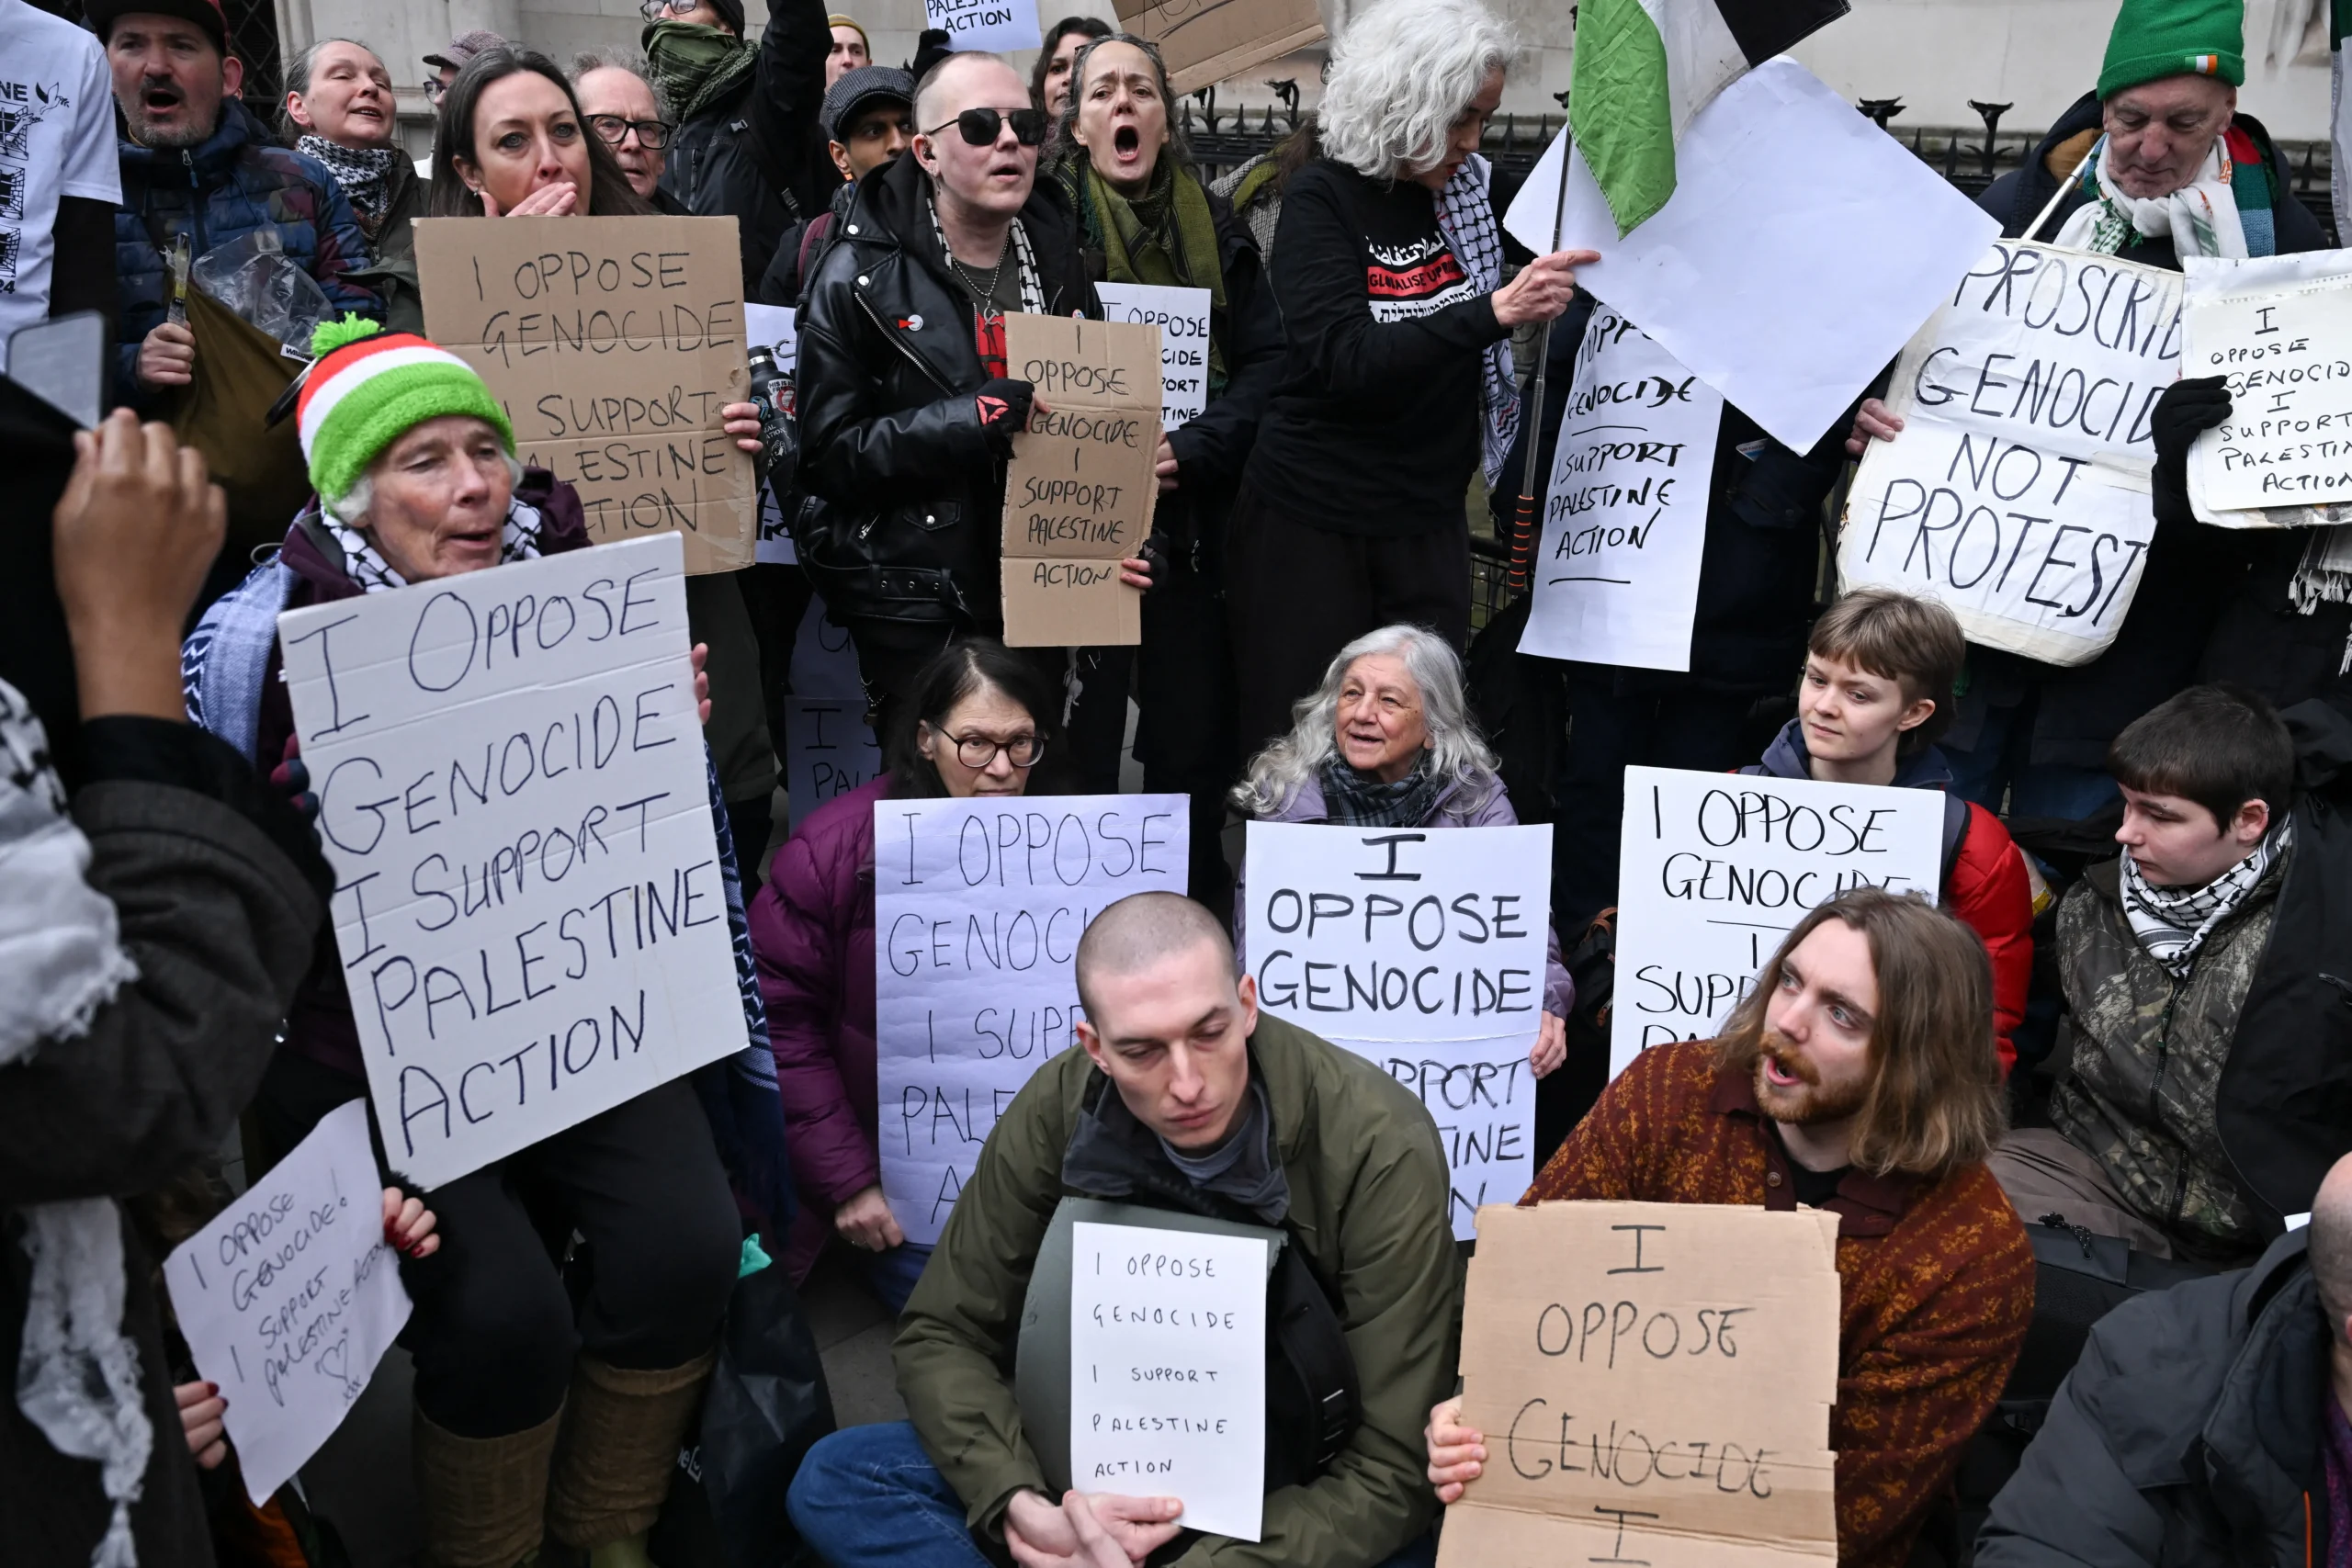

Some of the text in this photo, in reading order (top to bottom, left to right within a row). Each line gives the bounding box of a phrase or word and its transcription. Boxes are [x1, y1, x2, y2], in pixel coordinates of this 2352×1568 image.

[944, 8, 1012, 33] ACTION
[473, 252, 690, 301] I OPPOSE
[1128, 308, 1208, 337] OPPOSE
[1953, 243, 2182, 360] PROSCRI
[2255, 307, 2279, 334] I
[482, 300, 736, 367] GENOCIDE
[1077, 324, 1081, 355] I
[1162, 348, 1202, 366] CIDE
[1588, 315, 1653, 363] OPP
[2211, 338, 2309, 365] OPPOSE
[1024, 359, 1129, 395] OPPOSE
[1567, 376, 1697, 420] GENOCIDE
[1913, 346, 2167, 445] GENOCID
[2225, 361, 2350, 399] GENOCID
[2267, 389, 2296, 413] I
[537, 385, 717, 436] SUPPORT
[1031, 411, 1139, 448] GENOCIDE
[2220, 412, 2352, 442] SUPPORT
[528, 436, 728, 484] LESTINE
[1074, 447, 1080, 473] I
[1560, 442, 1687, 486] SUPPORT
[1947, 432, 2093, 506] NOT
[2217, 440, 2352, 471] PALESTI
[584, 479, 697, 534] TION
[1019, 476, 1122, 513] SUPPORT
[1548, 477, 1677, 525] PALESTINE
[1029, 513, 1125, 545] PALESTINE
[1555, 507, 1662, 560] ACTION
[1865, 478, 2149, 626] PROTEST
[1034, 562, 1113, 586] ACTION
[289, 568, 660, 741] I OPPOSE
[320, 684, 677, 854] GENOCIDE
[1653, 785, 1897, 855] I OPPOSE
[901, 813, 1171, 886] I OPPOSE
[1353, 833, 1427, 882] I
[334, 792, 670, 968] I SUPPORT
[1662, 852, 1911, 910] GENOC
[888, 908, 1088, 977] GENOC
[1267, 888, 1528, 952] OPPOSE
[371, 860, 719, 1055] PALESTINE
[1751, 932, 1758, 969] I
[1258, 949, 1533, 1018] GENOCIDE
[1635, 964, 1758, 1019] SUPP
[928, 1010, 935, 1064] I
[399, 989, 645, 1157] ACTION
[1380, 1057, 1529, 1111] PPORT
[190, 1193, 294, 1291] I OPPOSE
[1096, 1252, 1216, 1278] I OPPOSE
[1607, 1224, 1666, 1275] I
[231, 1265, 329, 1383] I SUPPORT
[1093, 1303, 1236, 1330] GENOCIDE
[1537, 1301, 1756, 1370] OPPOSE
[1093, 1364, 1218, 1383] I SUPPORT
[1093, 1413, 1228, 1434] PALESTINE
[1095, 1459, 1172, 1478] ACTION
[1509, 1398, 1781, 1499] GENOCIDE
[1588, 1505, 1659, 1566] I
